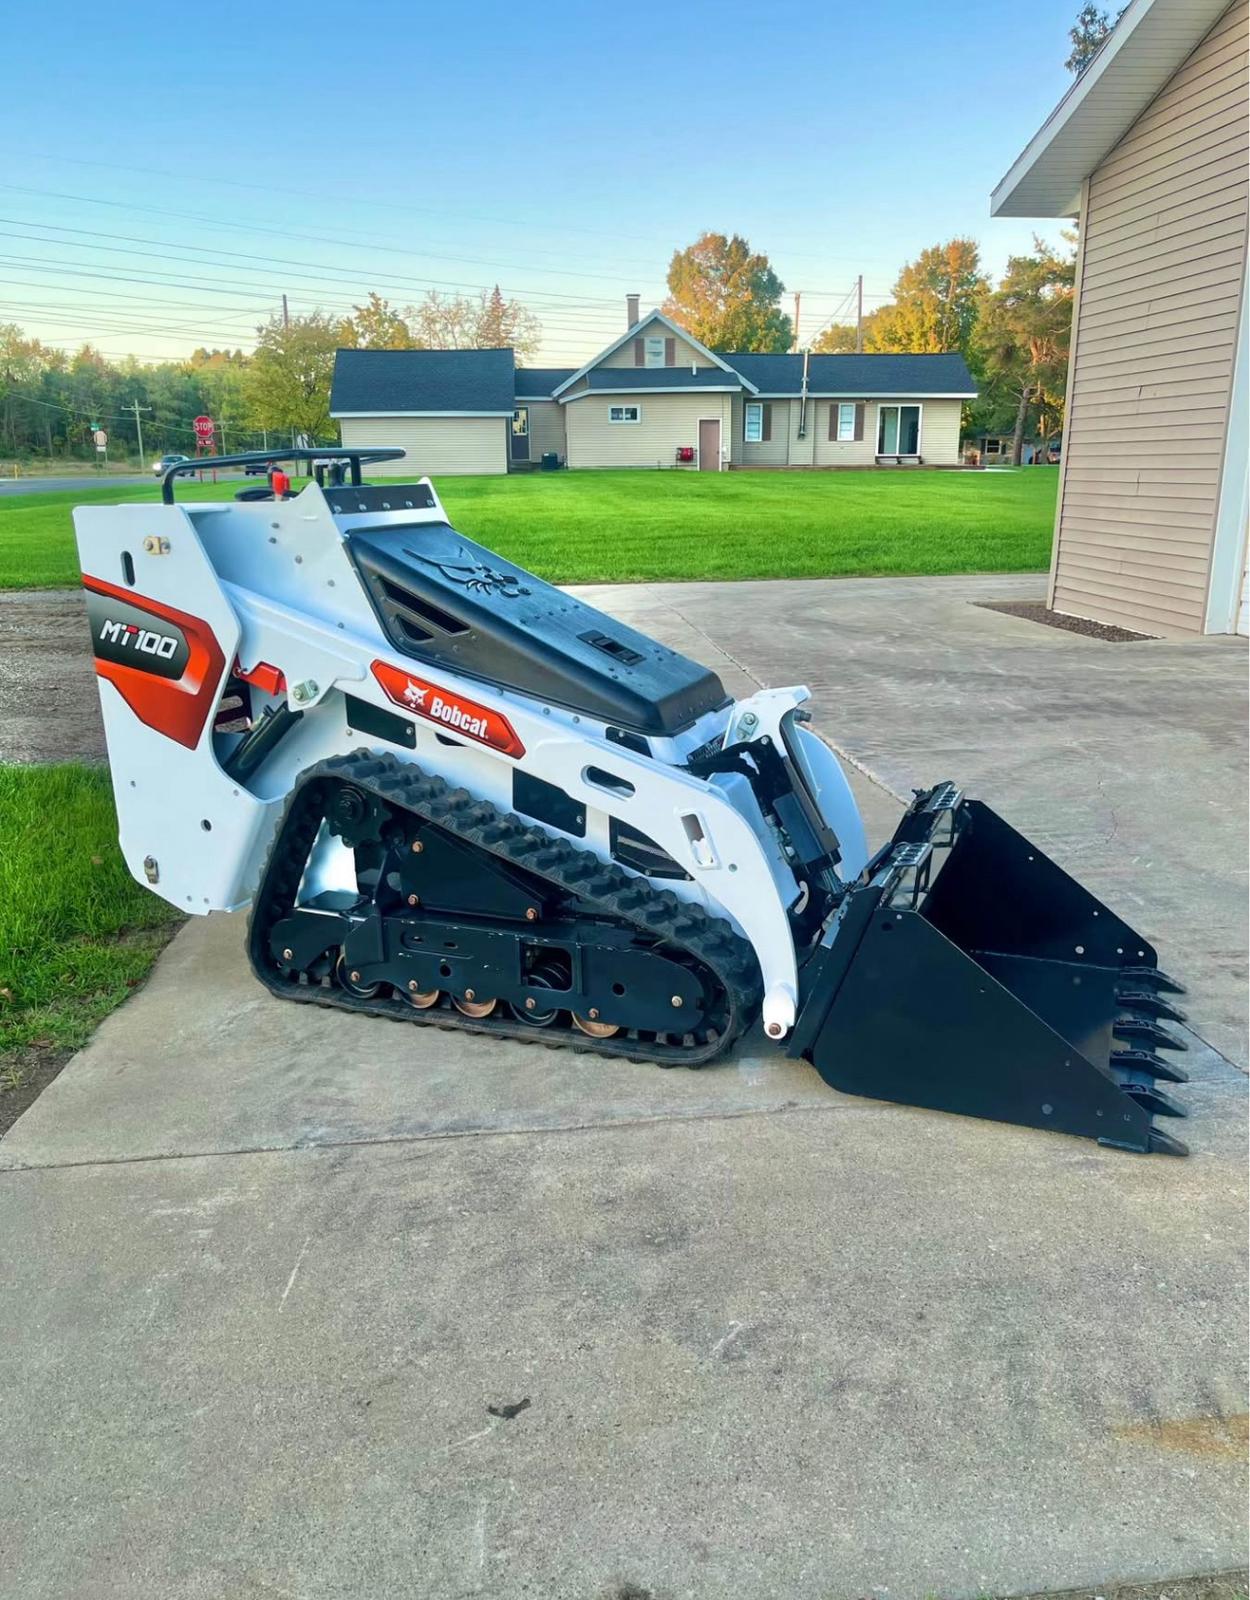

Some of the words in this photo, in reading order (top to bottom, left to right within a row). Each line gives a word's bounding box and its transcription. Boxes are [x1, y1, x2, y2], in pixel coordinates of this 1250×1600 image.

[195, 422, 213, 431] STOP
[100, 619, 178, 660] MT100
[429, 696, 488, 739] Bobcat
